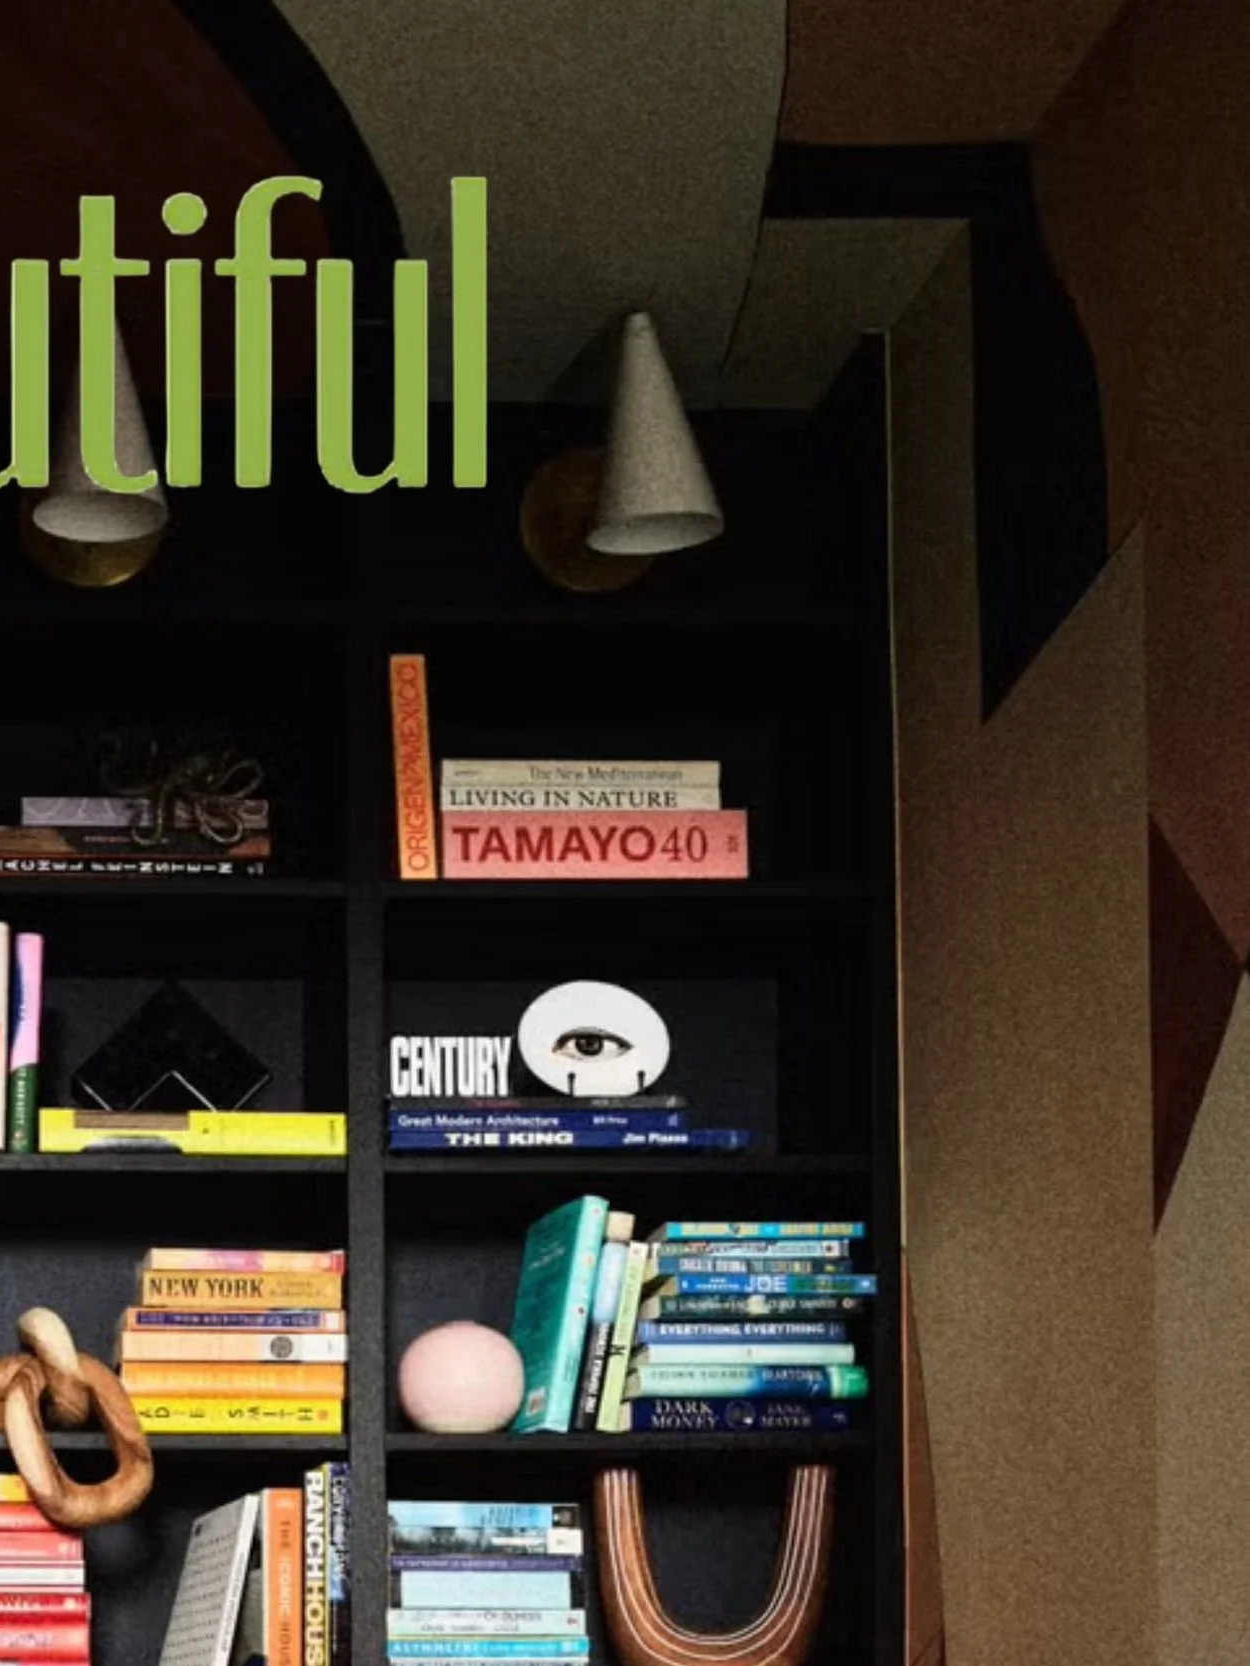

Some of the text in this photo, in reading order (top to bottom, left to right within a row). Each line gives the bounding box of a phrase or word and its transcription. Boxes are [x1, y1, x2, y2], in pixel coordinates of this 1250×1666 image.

[450, 789, 679, 808] LIVING IN NATURE
[452, 826, 708, 864] TAMAYO 40
[390, 1035, 513, 1097] CENTURY
[398, 1114, 559, 1127] Great Modern Architecture
[445, 1133, 574, 1146] THE KING
[150, 1278, 200, 1297] NEW
[206, 1277, 265, 1299] YORK
[744, 1322, 826, 1336] EVERYTHING
[655, 1399, 715, 1415] DARK
[651, 1414, 718, 1429] MONEY
[279, 1520, 292, 1549] THE
[306, 1471, 324, 1579] RANCH
[279, 1558, 292, 1617] ICONIC
